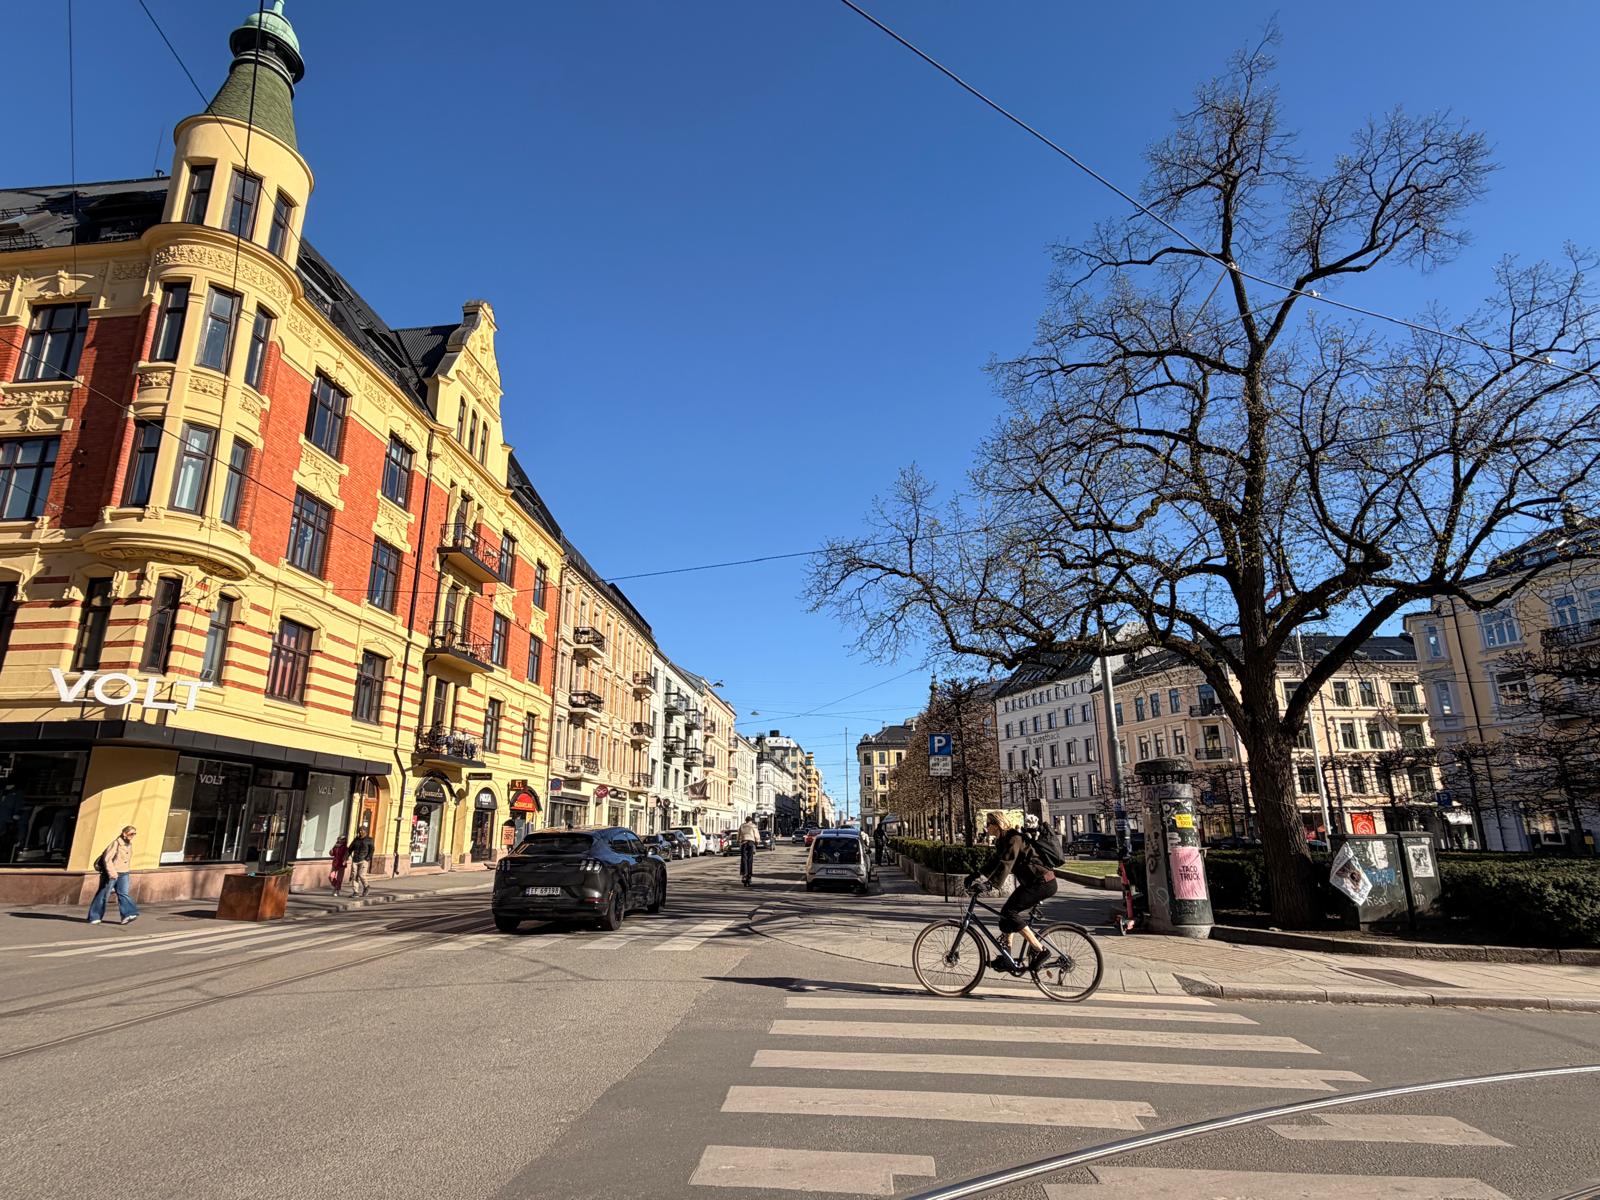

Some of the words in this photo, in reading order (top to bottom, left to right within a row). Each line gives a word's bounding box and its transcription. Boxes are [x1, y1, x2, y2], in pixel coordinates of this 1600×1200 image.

[48, 667, 213, 712] VOLT
[934, 736, 946, 753] P
[199, 773, 226, 785] VOLT
[318, 785, 336, 795] VOLT
[1182, 865, 1198, 873] TACO
[1179, 872, 1200, 881] TRUCK
